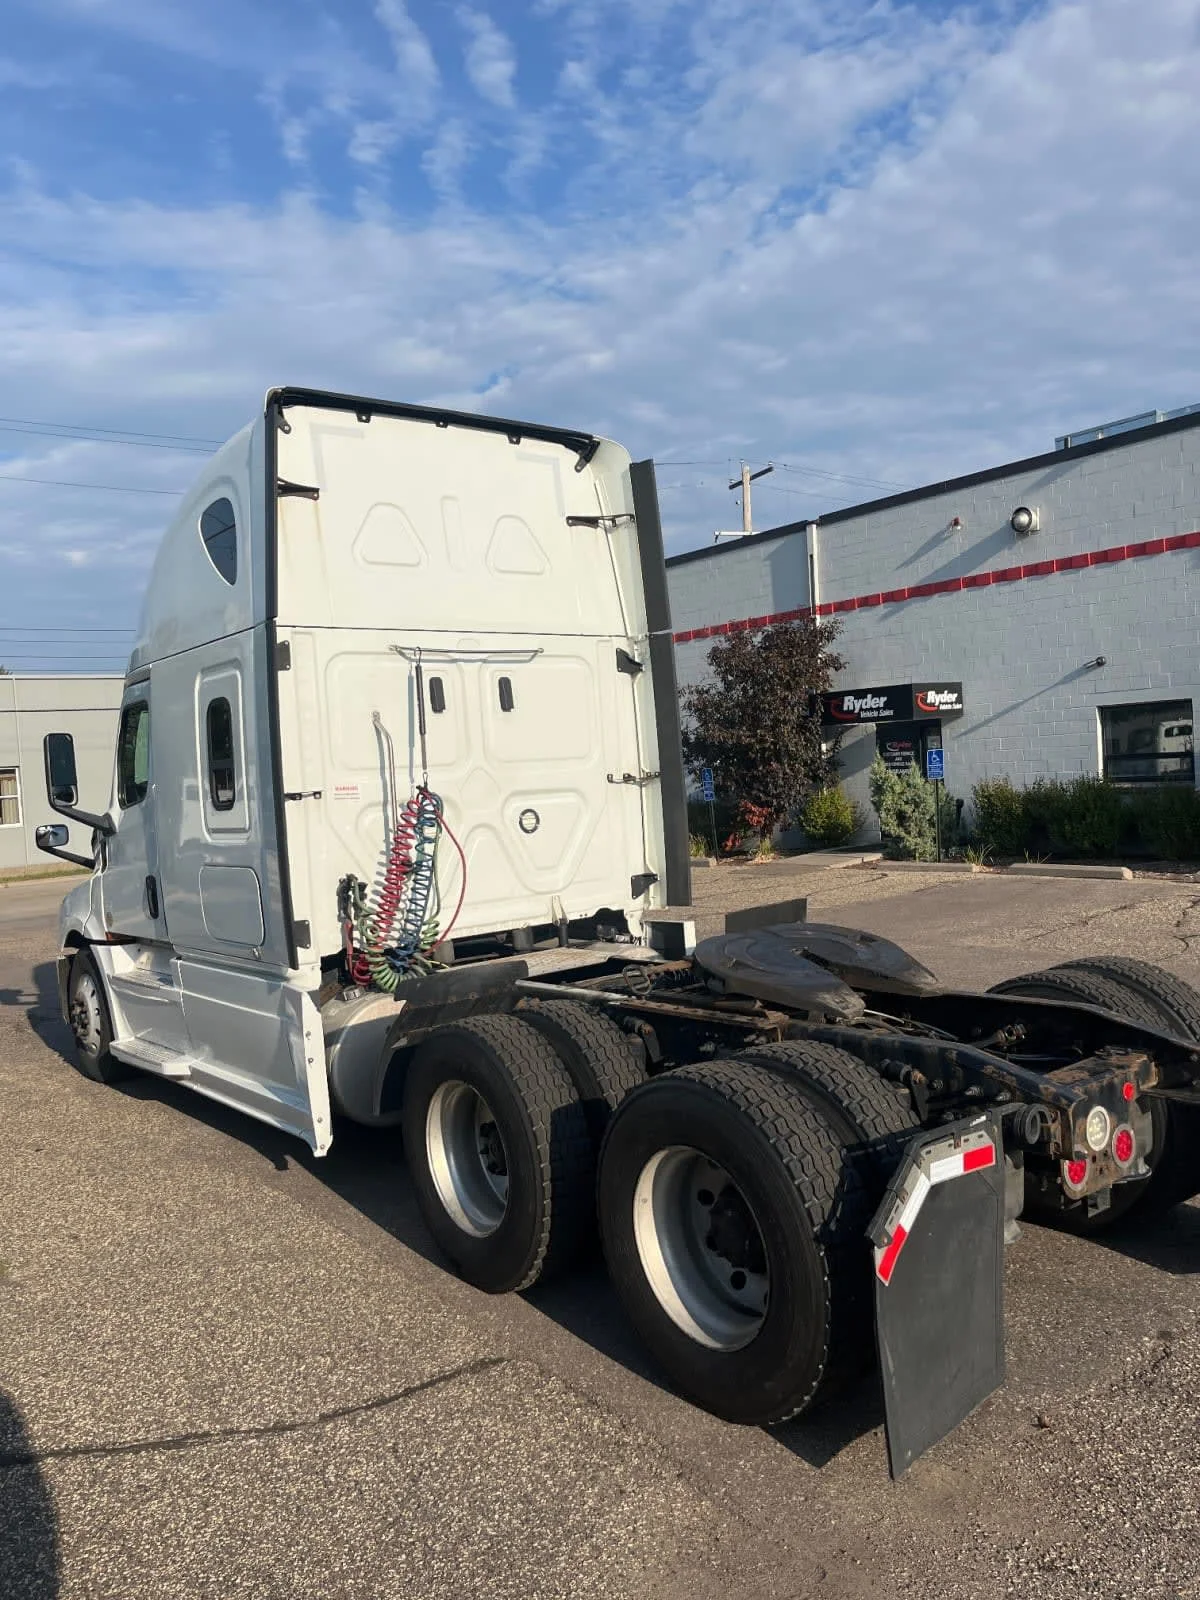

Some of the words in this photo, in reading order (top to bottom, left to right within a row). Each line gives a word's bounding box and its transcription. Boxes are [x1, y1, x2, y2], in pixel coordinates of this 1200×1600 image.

[843, 694, 887, 713] Ryder
[927, 690, 958, 706] Ryder
[860, 709, 879, 718] Vehicle
[879, 709, 894, 717] Sales
